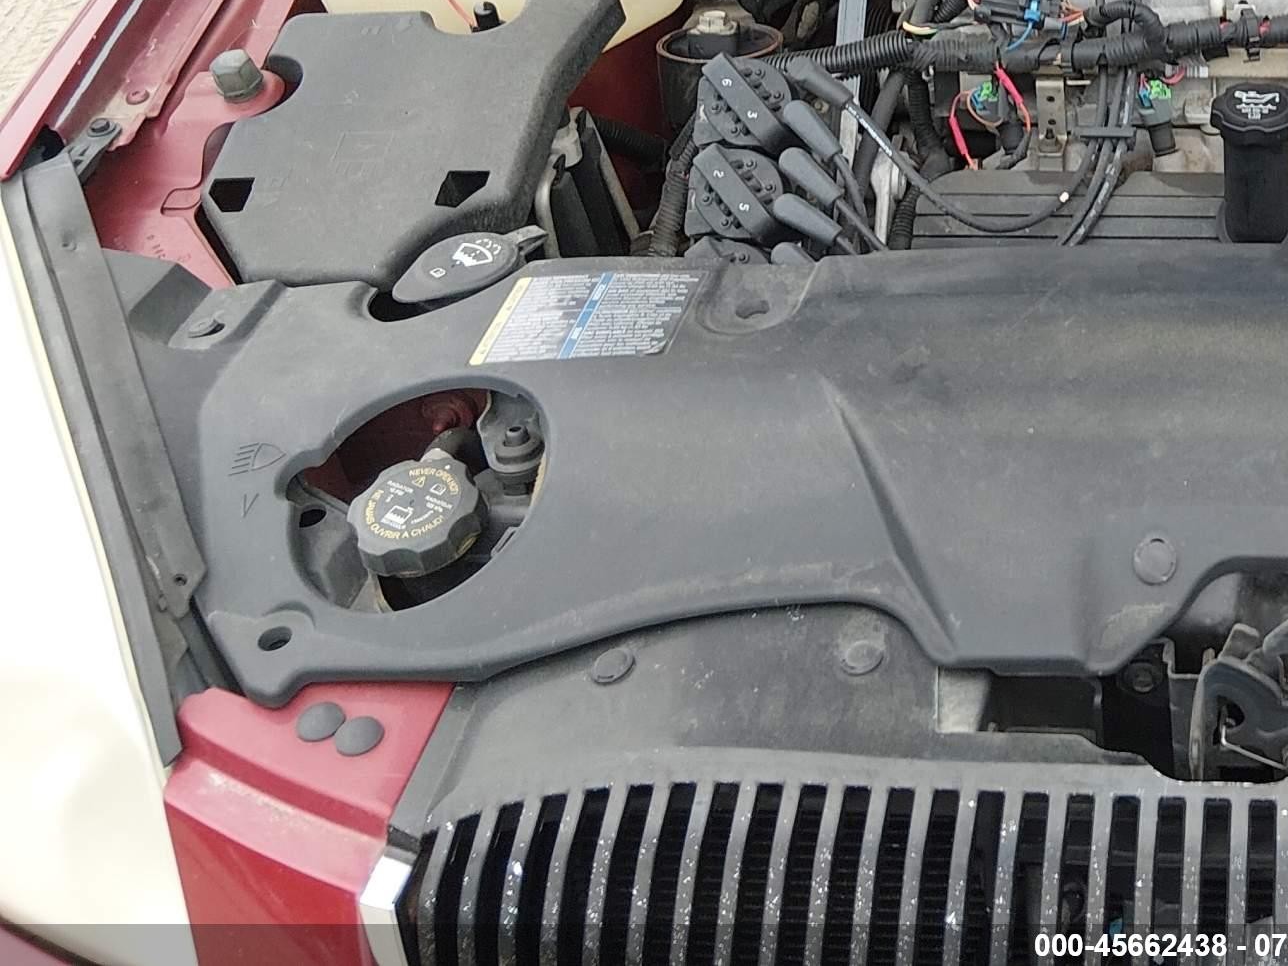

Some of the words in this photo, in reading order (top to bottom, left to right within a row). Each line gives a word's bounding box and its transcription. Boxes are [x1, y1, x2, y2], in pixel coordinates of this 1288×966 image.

[721, 78, 732, 87] 6
[747, 109, 758, 119] 3
[713, 169, 724, 179] 2
[738, 202, 750, 212] 5
[409, 468, 435, 477] NEVER
[370, 523, 401, 539] OUVRIR
